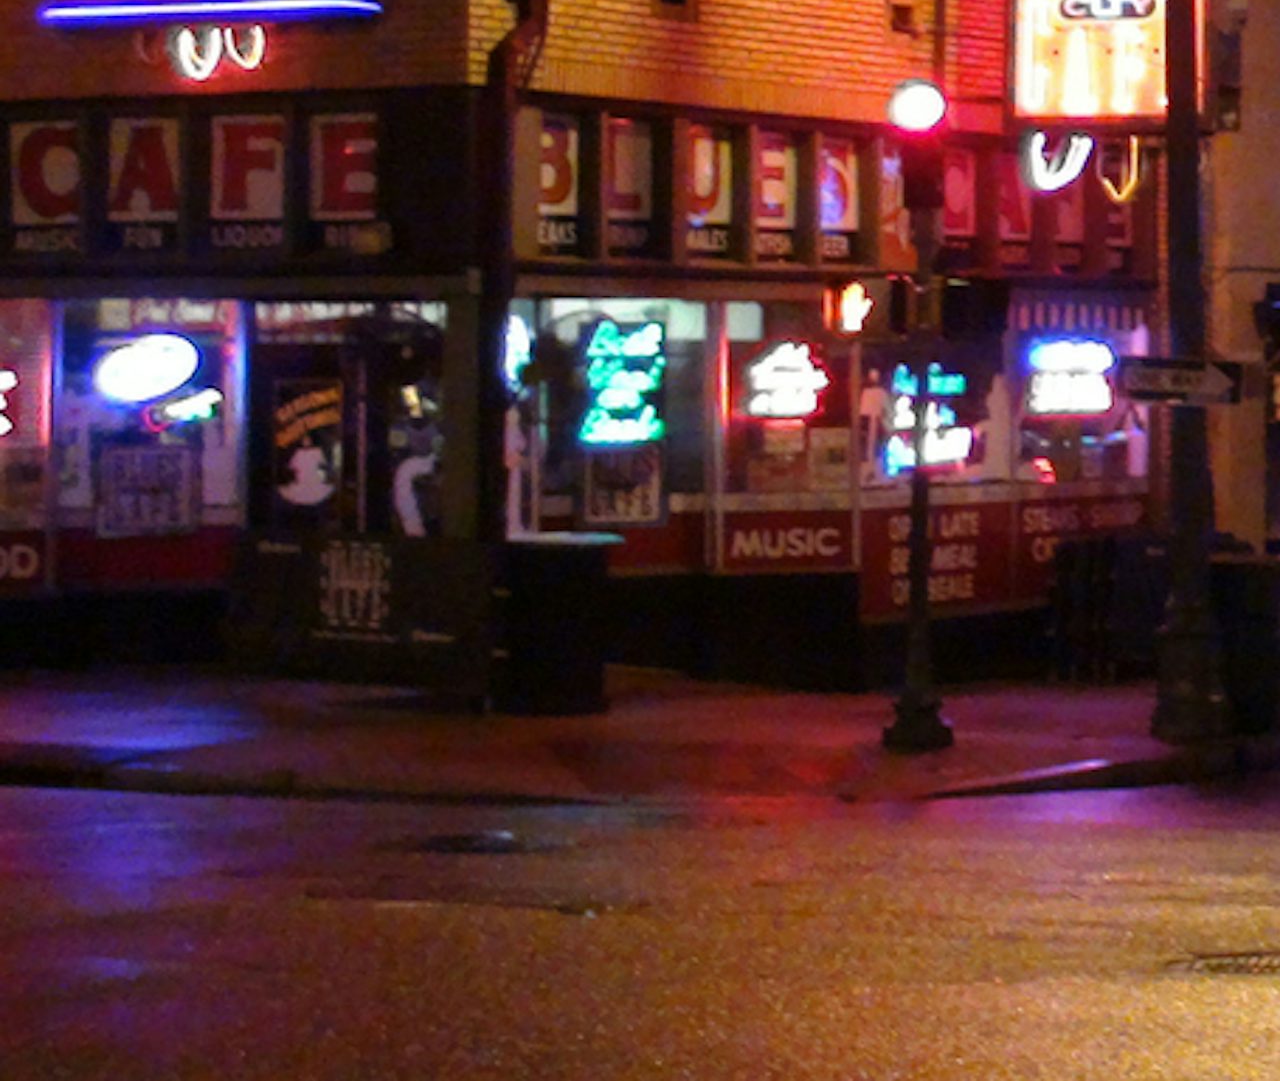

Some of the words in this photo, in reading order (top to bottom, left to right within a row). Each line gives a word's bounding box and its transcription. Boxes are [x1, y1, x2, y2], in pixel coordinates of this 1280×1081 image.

[19, 122, 377, 218] CAFE
[210, 224, 284, 248] LIQUOR
[730, 527, 842, 559] MUSIC
